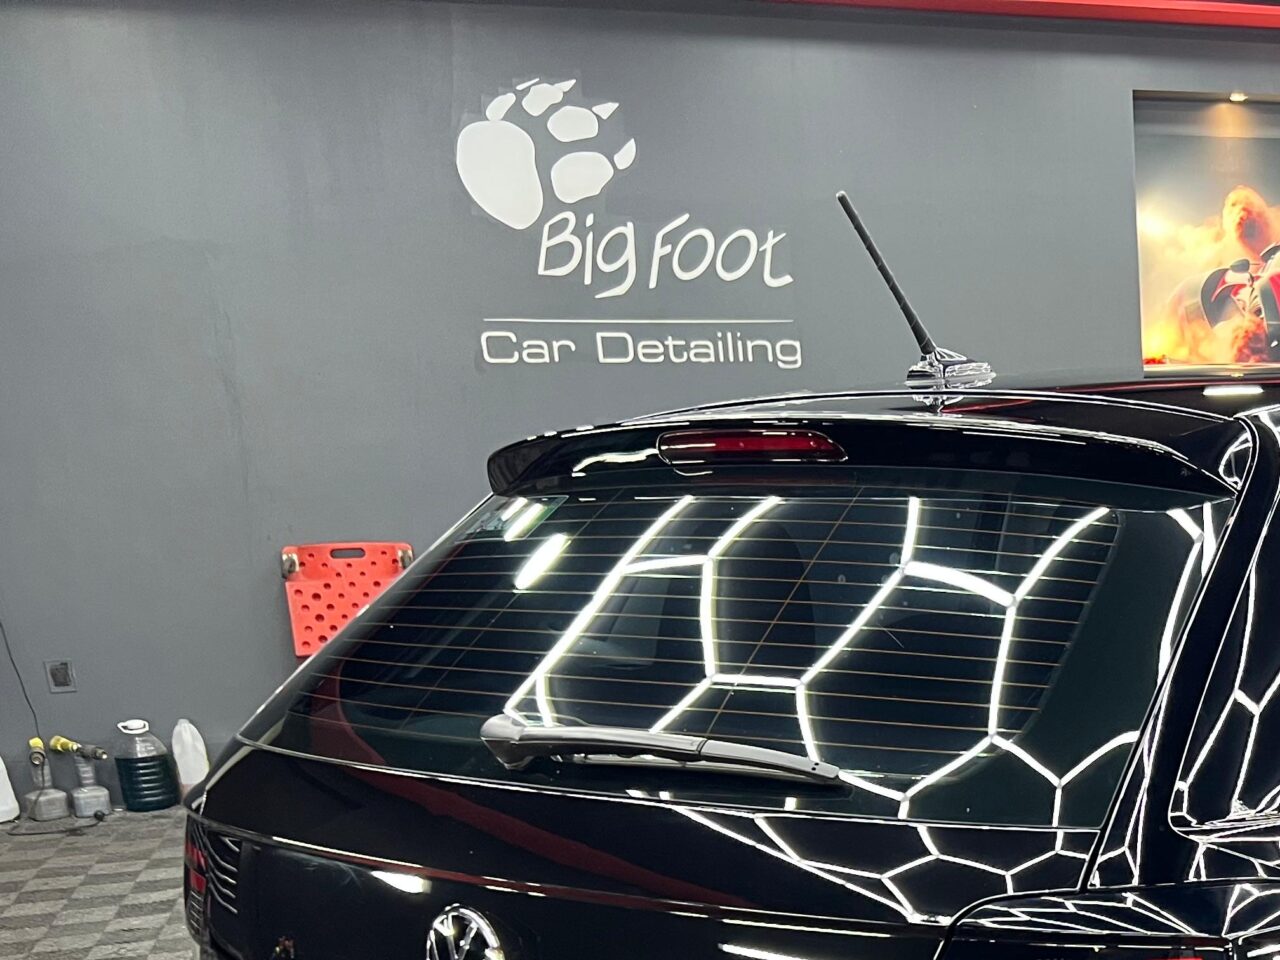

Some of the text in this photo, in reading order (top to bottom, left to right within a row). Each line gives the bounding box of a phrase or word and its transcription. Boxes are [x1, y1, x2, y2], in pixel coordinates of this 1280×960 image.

[538, 211, 637, 299] Big
[480, 330, 803, 369] Car Detailing
